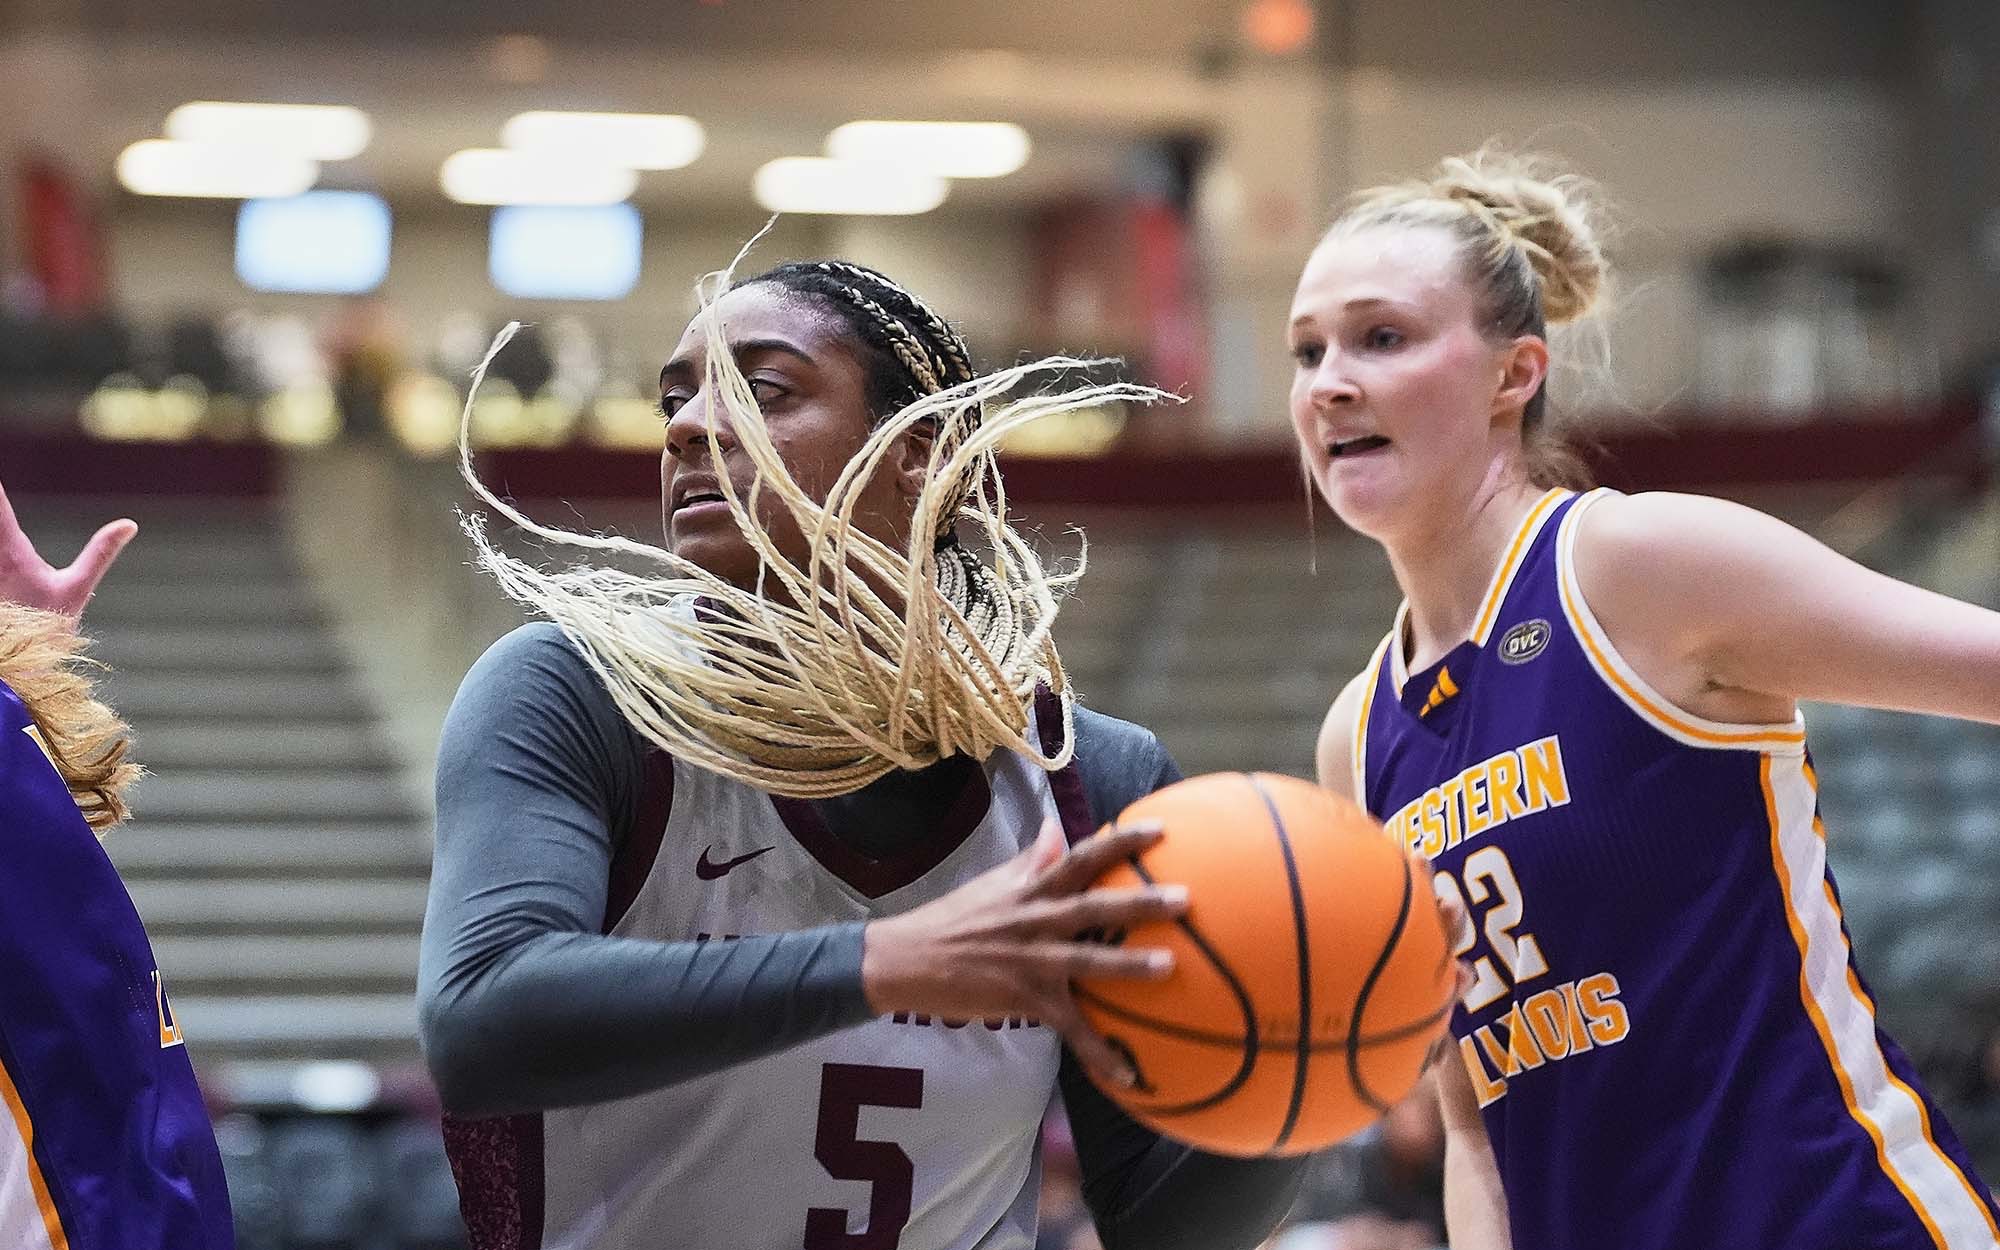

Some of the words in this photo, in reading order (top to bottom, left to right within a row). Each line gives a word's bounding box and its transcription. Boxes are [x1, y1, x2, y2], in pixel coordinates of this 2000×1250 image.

[1509, 629, 1540, 655] OVC
[1433, 845, 1549, 1014] 22
[803, 1063, 924, 1250] 5
